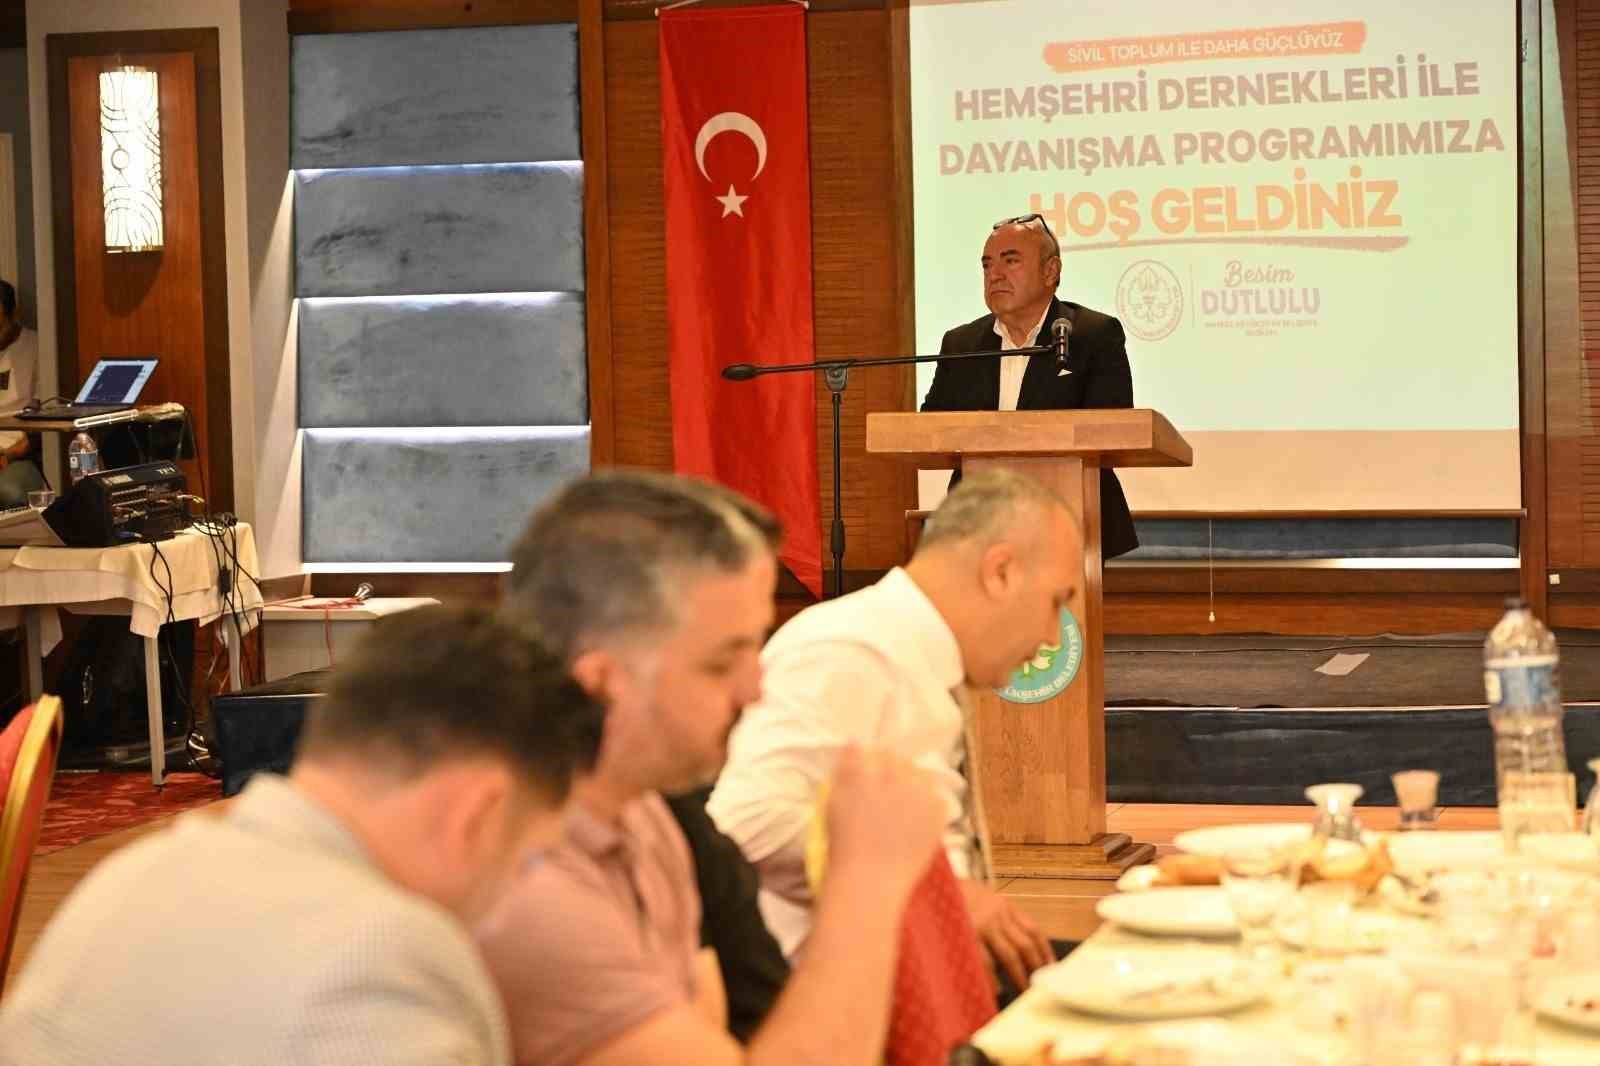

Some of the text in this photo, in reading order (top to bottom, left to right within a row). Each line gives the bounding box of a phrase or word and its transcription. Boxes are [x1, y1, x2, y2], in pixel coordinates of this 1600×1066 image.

[1067, 46, 1105, 64] SİVİL
[1110, 43, 1174, 61] TOPLUM
[1204, 37, 1249, 55] DAHA
[1253, 31, 1344, 53] GÜÇLÜYÜZ
[955, 53, 1479, 122] HEMŞEHRİ DERNEKLERİ İLE
[939, 118, 1505, 176] DAYANIŞMA PROGRAMIMIZA
[1029, 166, 1401, 245] HOŞ GELDİNİZ
[1224, 260, 1295, 287] Besim
[1200, 287, 1320, 315] DUTLULU
